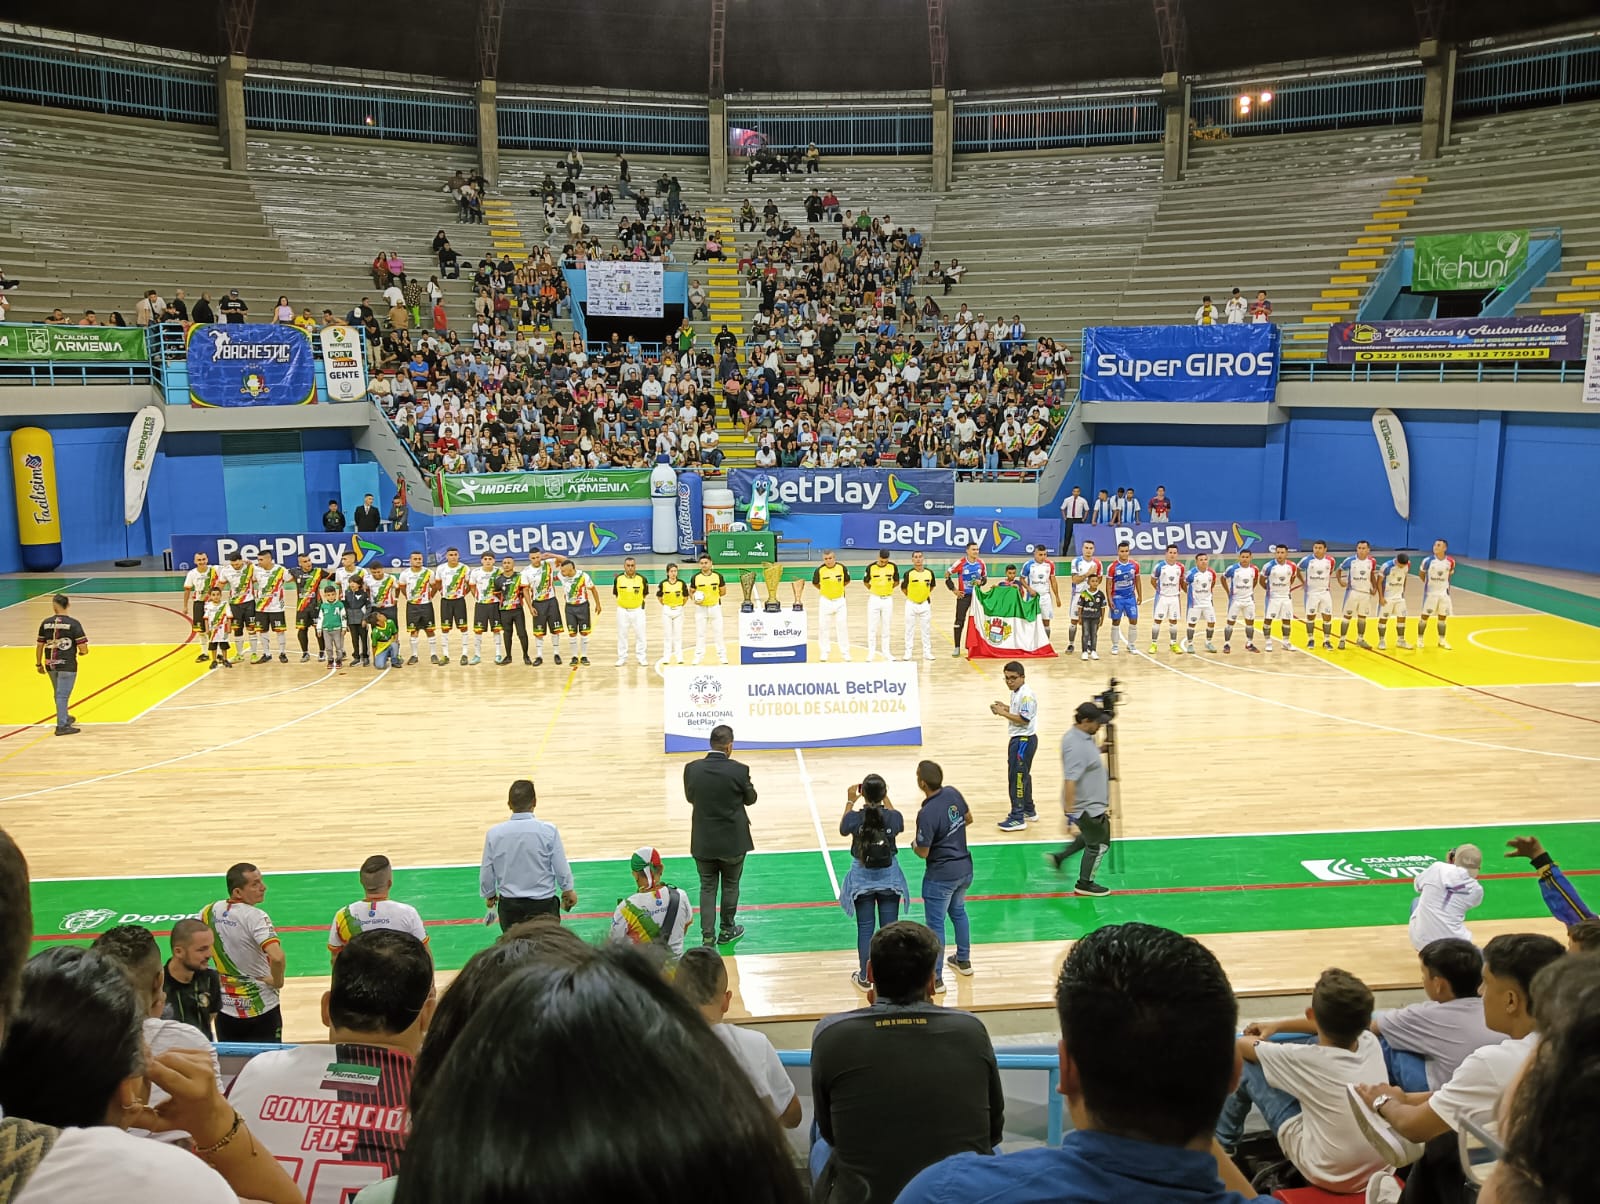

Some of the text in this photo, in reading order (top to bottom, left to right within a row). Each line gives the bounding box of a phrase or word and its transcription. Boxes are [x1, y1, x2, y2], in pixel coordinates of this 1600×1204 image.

[1418, 254, 1508, 281] Lifehuni
[1385, 323, 1567, 339] Eléctricos y Automáticos
[55, 341, 124, 352] ARMENIA
[222, 344, 290, 361] BACHESTIC
[329, 370, 360, 379] GENTE
[1097, 352, 1274, 382] Super GIROS
[137, 416, 152, 461] INDEPORTES
[481, 482, 529, 495] IMDERA
[568, 482, 630, 494] ARMENIA
[765, 474, 883, 510] BetPlay
[468, 524, 585, 556] BetPlay
[878, 520, 988, 548] BetPlay
[1114, 523, 1229, 554] BetPlay
[773, 629, 802, 637] BetPlay
[748, 679, 907, 697] LIGA NACIONAL BetPlay
[696, 710, 734, 718] NACIONAL
[749, 696, 907, 717] FÚTBOL DE SALÓN 2024
[687, 718, 717, 727] BetPlay
[1361, 855, 1438, 864] COLOMBIA
[1374, 867, 1426, 878] VID
[260, 1096, 412, 1134] CONVENCIÓ
[301, 1125, 358, 1153] FDS
